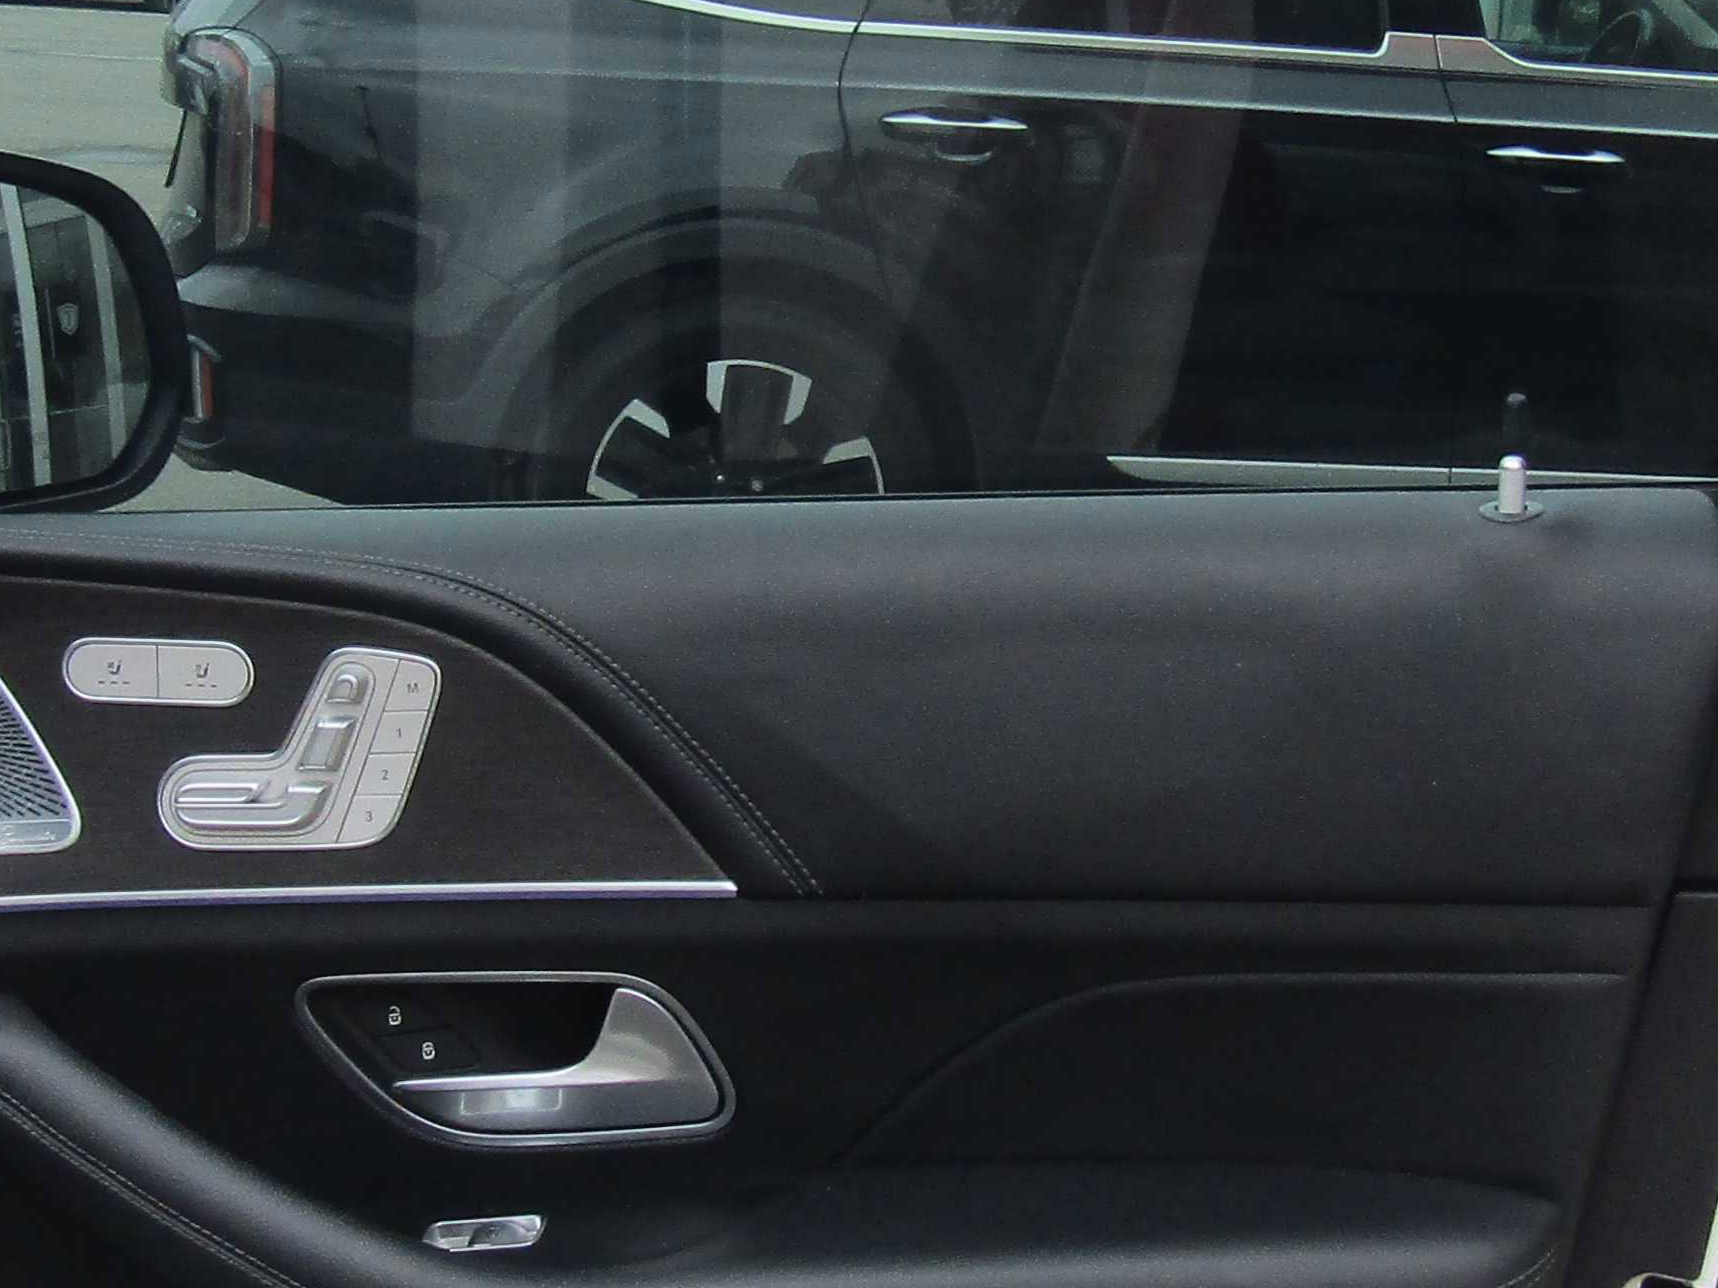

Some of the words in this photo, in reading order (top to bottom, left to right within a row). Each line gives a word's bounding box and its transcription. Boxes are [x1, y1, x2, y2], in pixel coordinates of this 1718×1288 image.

[407, 683, 419, 694] M
[396, 728, 402, 738] 1
[381, 770, 389, 780] 2
[365, 811, 373, 822] 3
